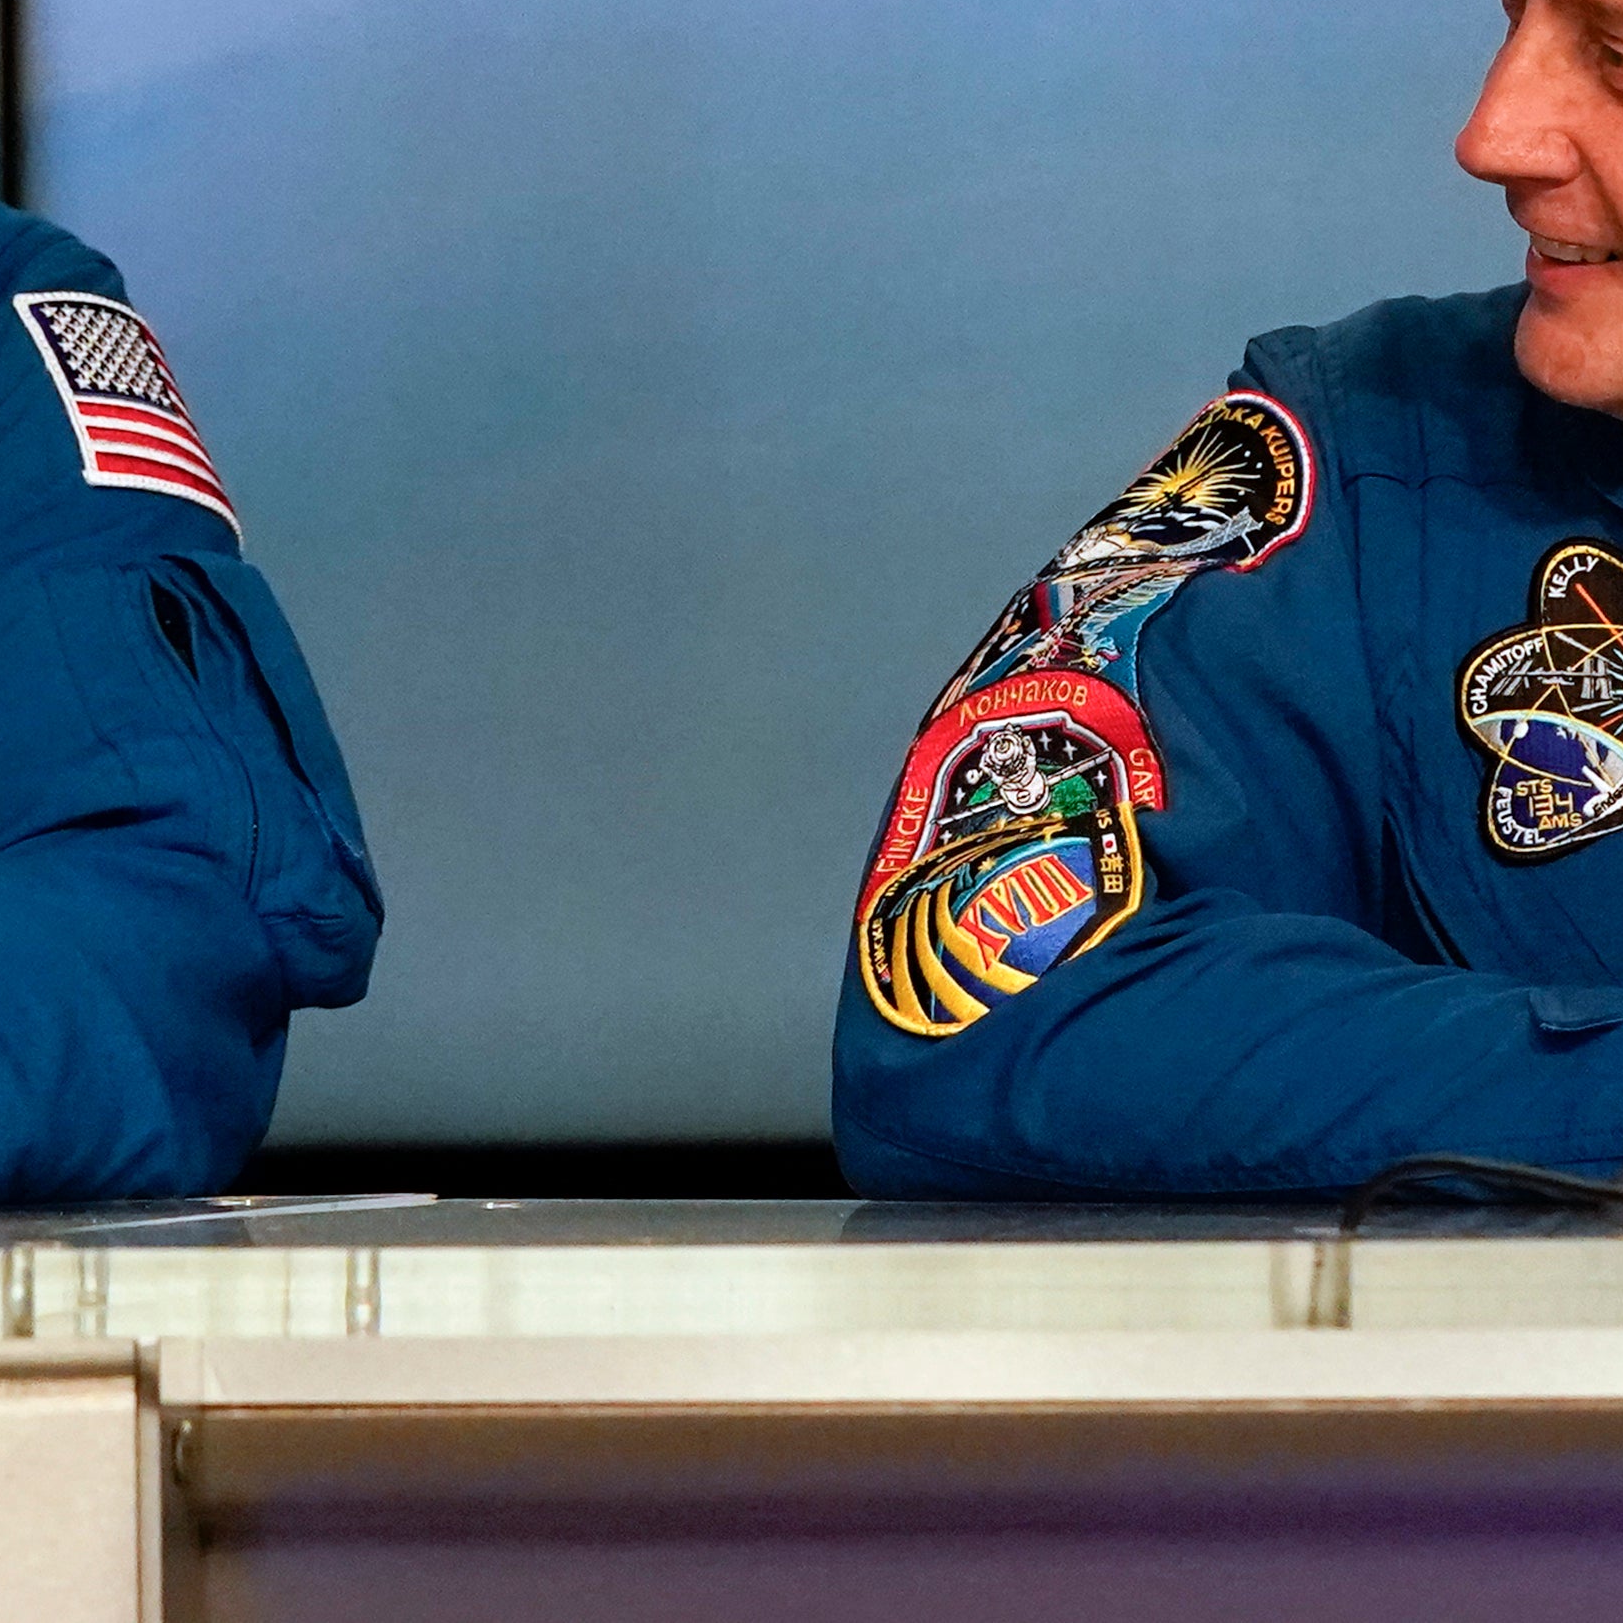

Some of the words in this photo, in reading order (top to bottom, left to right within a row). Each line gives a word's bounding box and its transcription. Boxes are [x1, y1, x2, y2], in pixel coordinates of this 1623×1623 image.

[1259, 425, 1296, 526] KUIPERS
[1547, 555, 1599, 599] KELLY
[1470, 636, 1544, 715] CHAMITOFF
[1129, 747, 1156, 809] GAR
[1515, 778, 1553, 797] STS
[1496, 786, 1546, 845] FEUSTEL
[1528, 791, 1574, 818] 134
[1537, 812, 1583, 832] AMS
[876, 786, 928, 875] FINCKE
[1099, 852, 1125, 894] 若田
